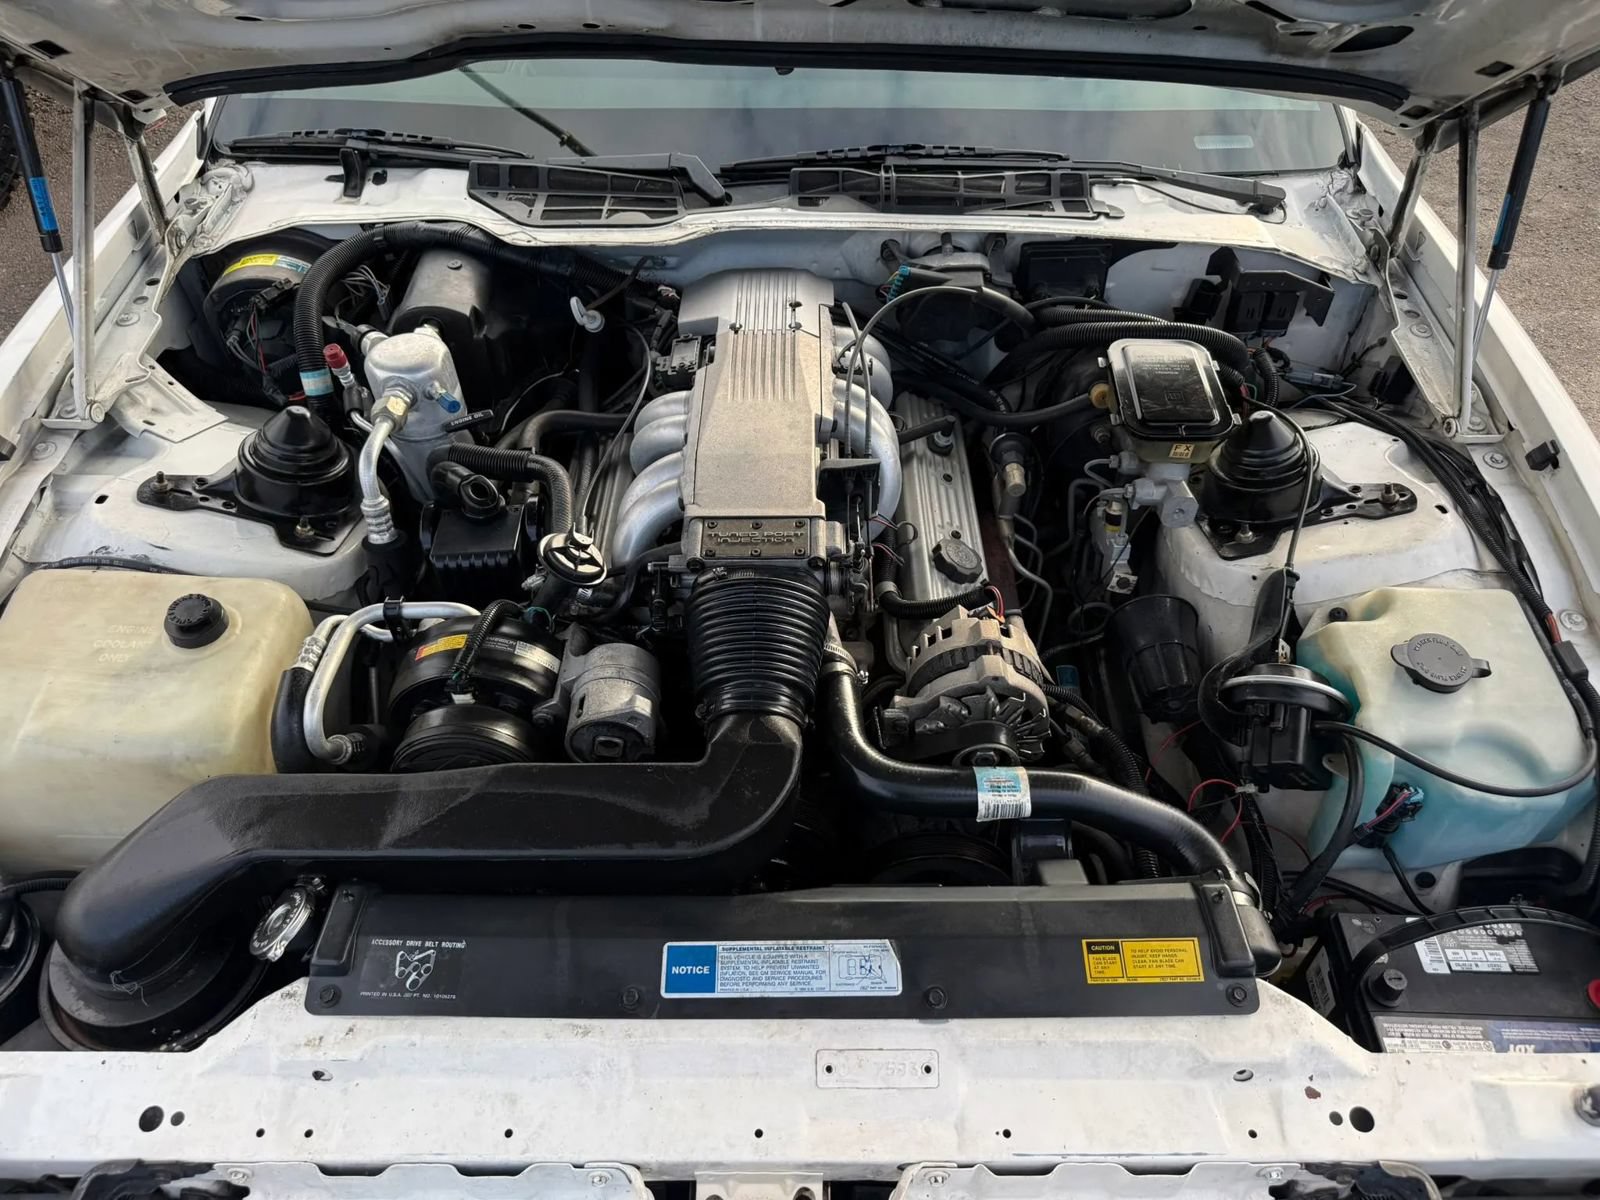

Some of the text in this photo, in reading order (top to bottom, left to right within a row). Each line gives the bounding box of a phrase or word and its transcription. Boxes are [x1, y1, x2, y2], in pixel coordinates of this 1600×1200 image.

[451, 415, 472, 426] ENGINE
[372, 938, 402, 946] ACCESSORY
[672, 966, 710, 974] NOTICE
